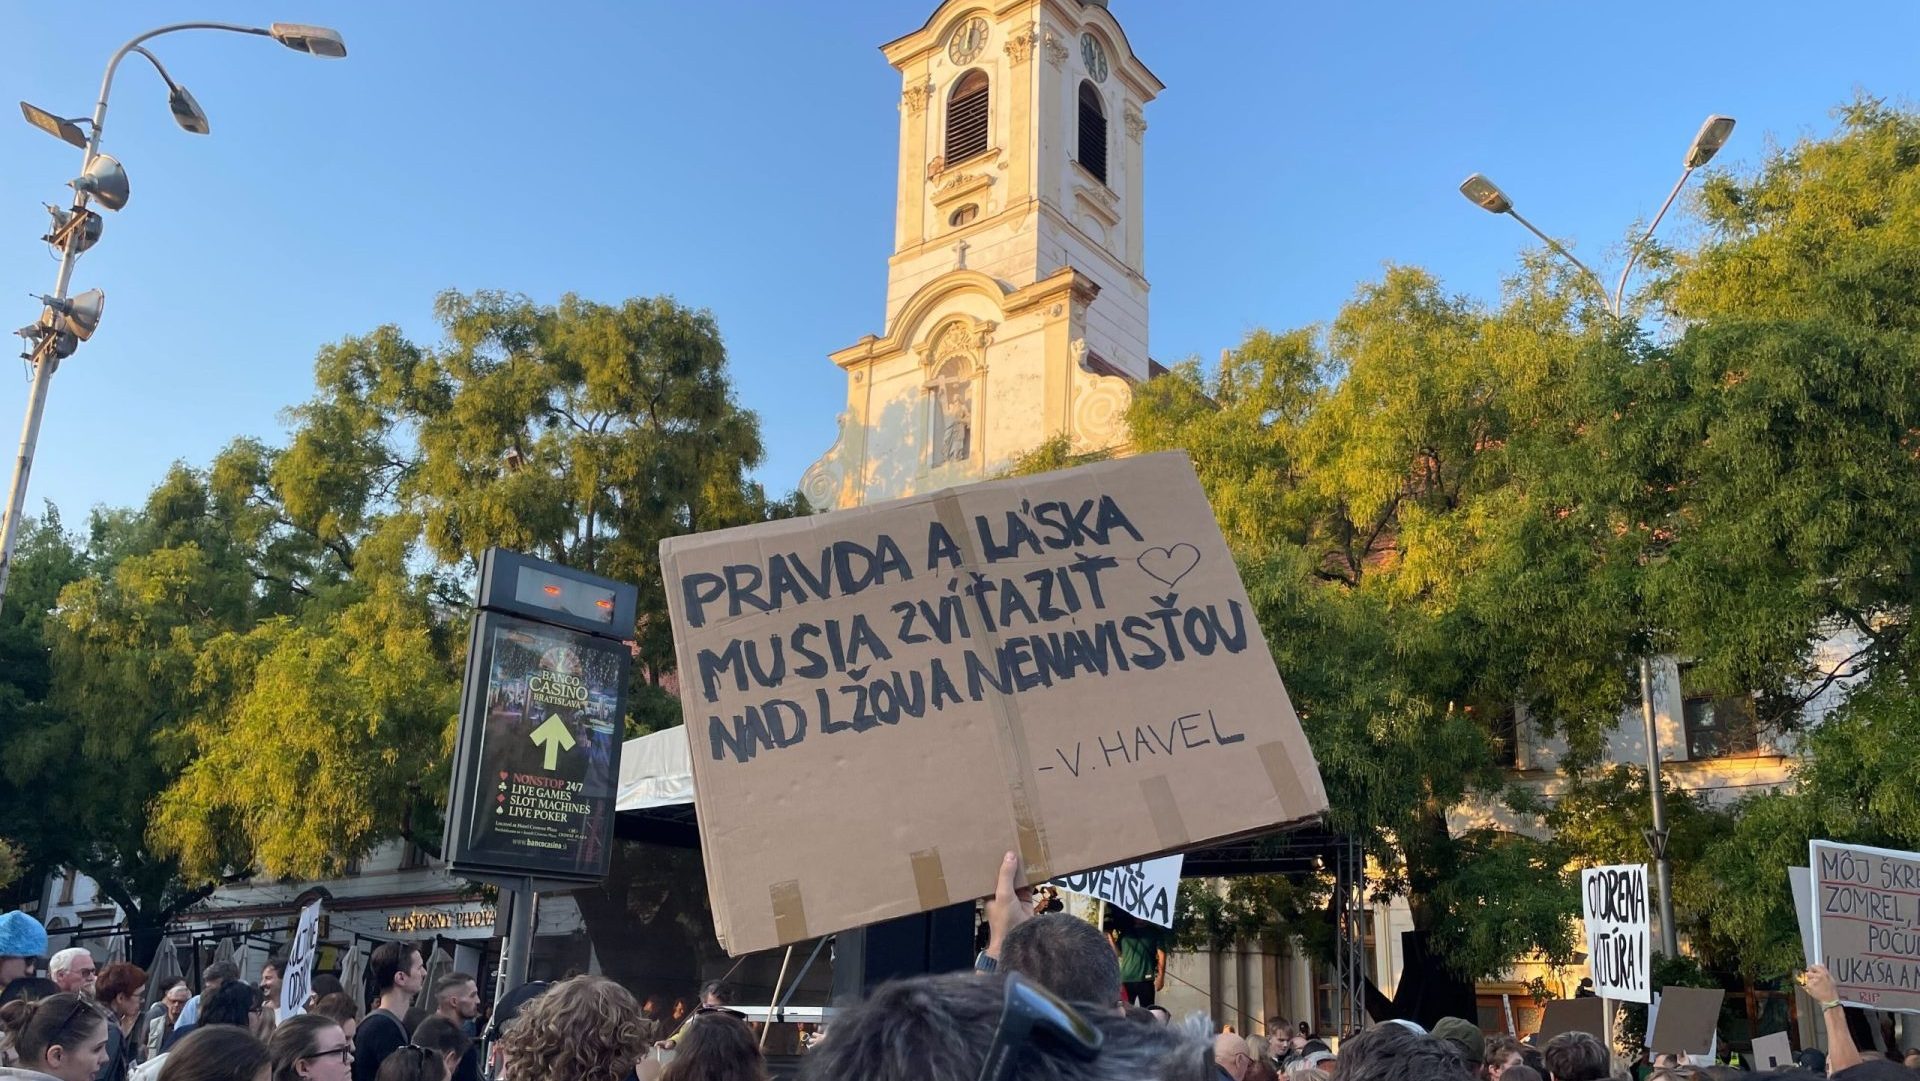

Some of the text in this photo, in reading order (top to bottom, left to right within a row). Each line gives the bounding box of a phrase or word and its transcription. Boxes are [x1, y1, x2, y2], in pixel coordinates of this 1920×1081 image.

[682, 495, 1144, 628] PRAVDA A LÁSKA
[697, 614, 893, 702] MUSIA
[542, 670, 580, 686] BANCO
[708, 592, 1247, 763] NAD LŽOU A NENAVISŤOU
[529, 677, 588, 700] CASINO
[534, 693, 581, 709] BRATISLAVA
[1098, 710, 1245, 767] HAVEL
[511, 784, 571, 801] LIVE GAMES
[513, 773, 583, 793] NONSTOP 24/7
[508, 806, 568, 822] LIVE POKER
[509, 795, 591, 814] SLOT MACHINES
[1821, 850, 1870, 884] MÔJ
[456, 911, 496, 928] PIVOVA
[1859, 991, 1880, 1003] RIP
